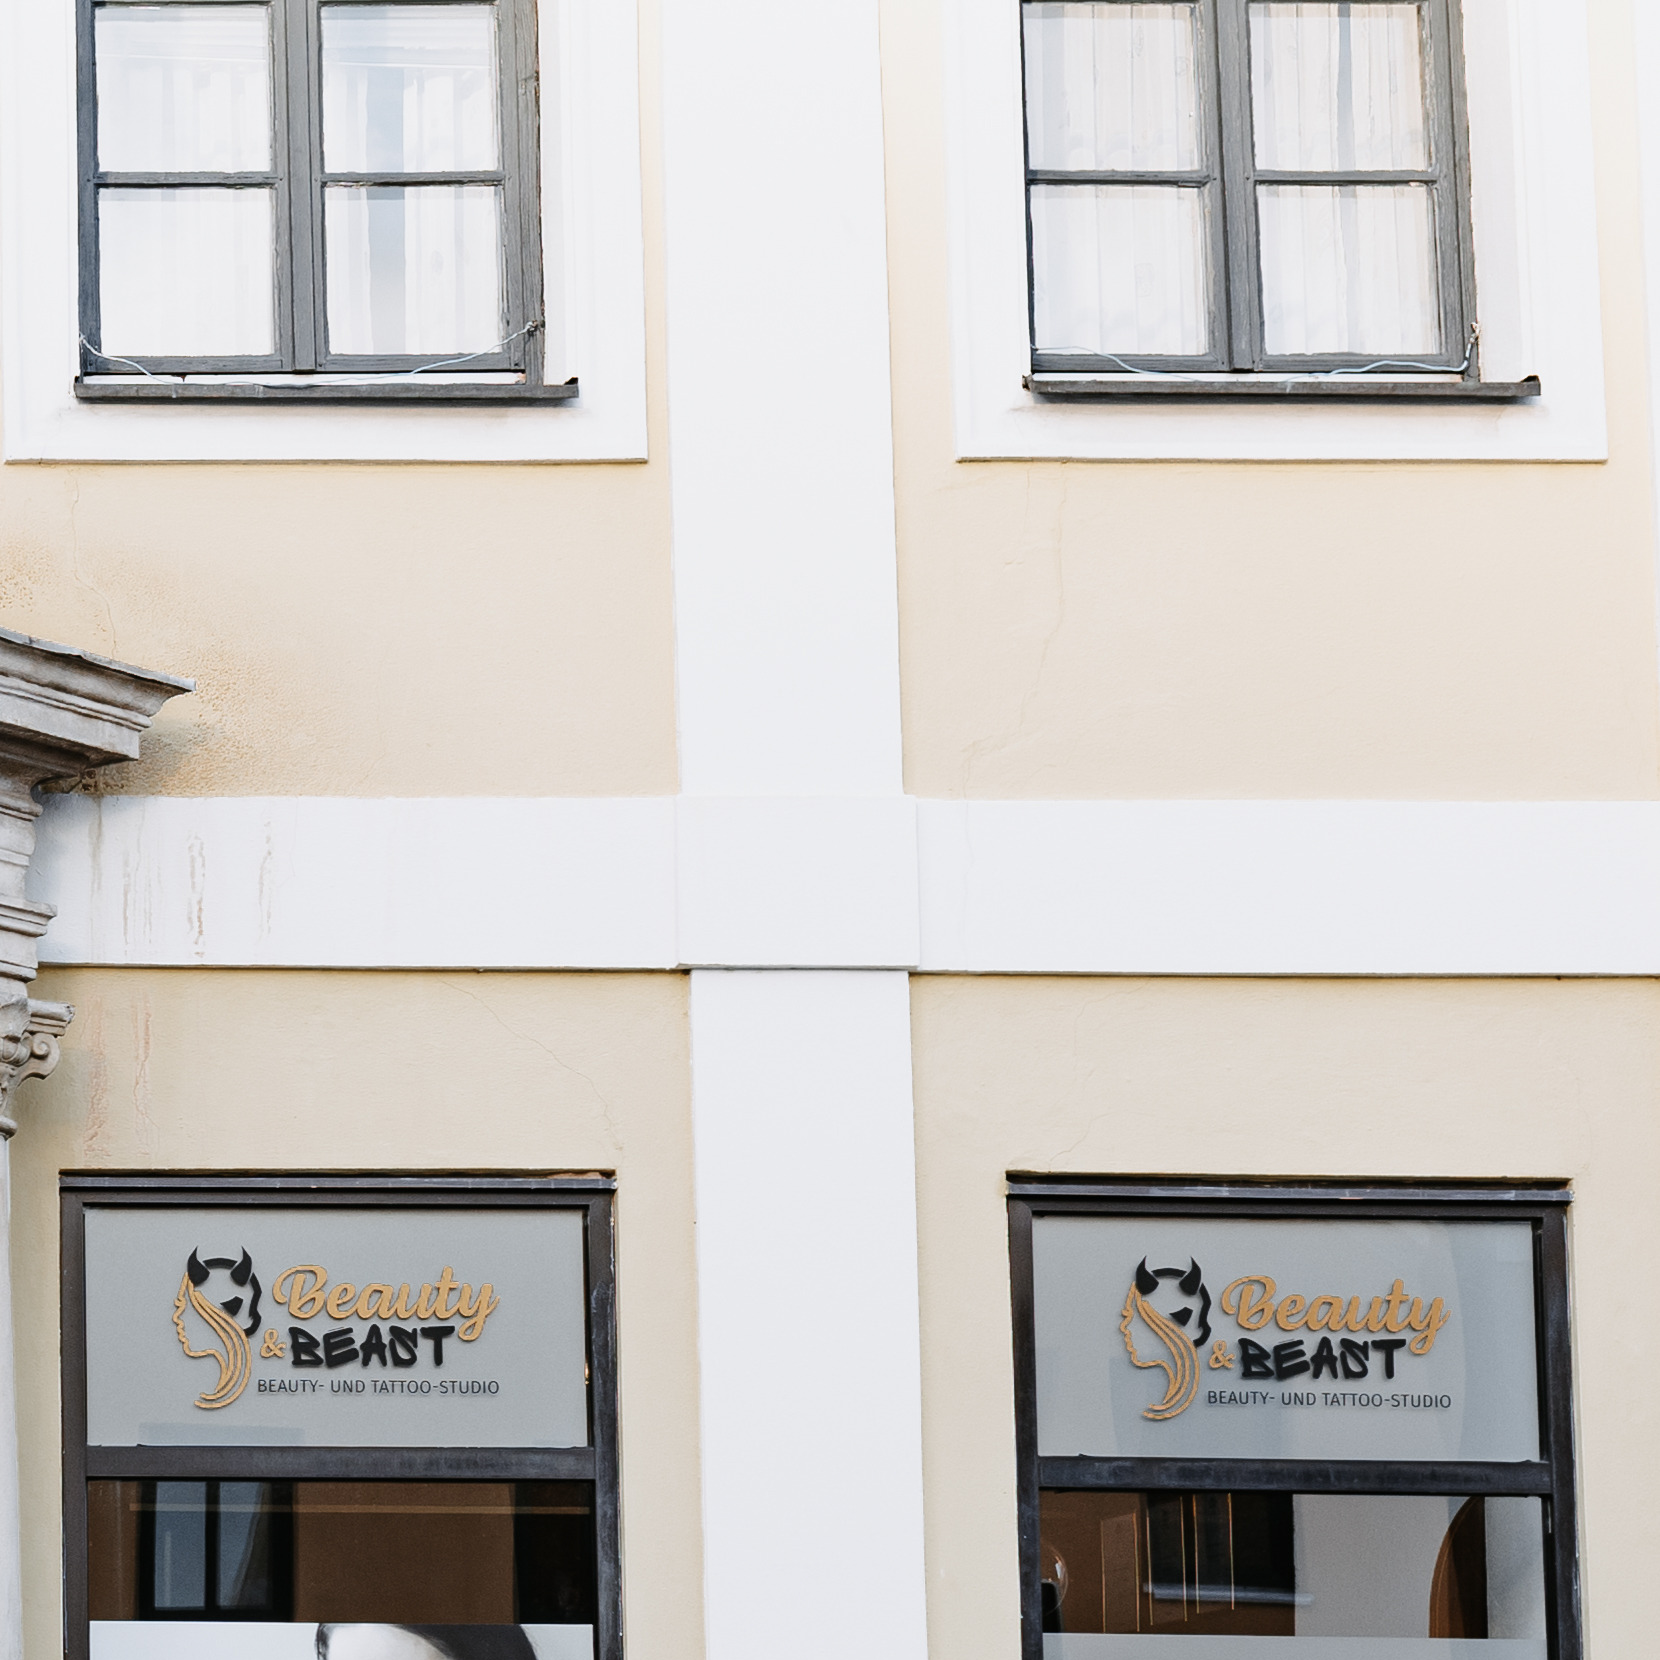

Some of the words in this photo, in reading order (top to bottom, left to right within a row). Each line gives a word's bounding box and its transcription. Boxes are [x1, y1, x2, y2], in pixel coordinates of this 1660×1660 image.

[273, 1264, 501, 1341] Beauty
[1221, 1275, 1452, 1355] Beauty
[260, 1329, 286, 1358] &
[289, 1324, 456, 1368] BEAST
[1210, 1340, 1236, 1370] &
[1238, 1337, 1408, 1380] BEAST
[257, 1378, 325, 1394] BEAUTY-
[331, 1379, 366, 1394] UND
[371, 1379, 500, 1395] TATTOO-STUDIO
[1207, 1390, 1275, 1407] BEAUTY-
[1282, 1391, 1317, 1407] UND
[1322, 1392, 1452, 1409] TATTOO-STUDIO
